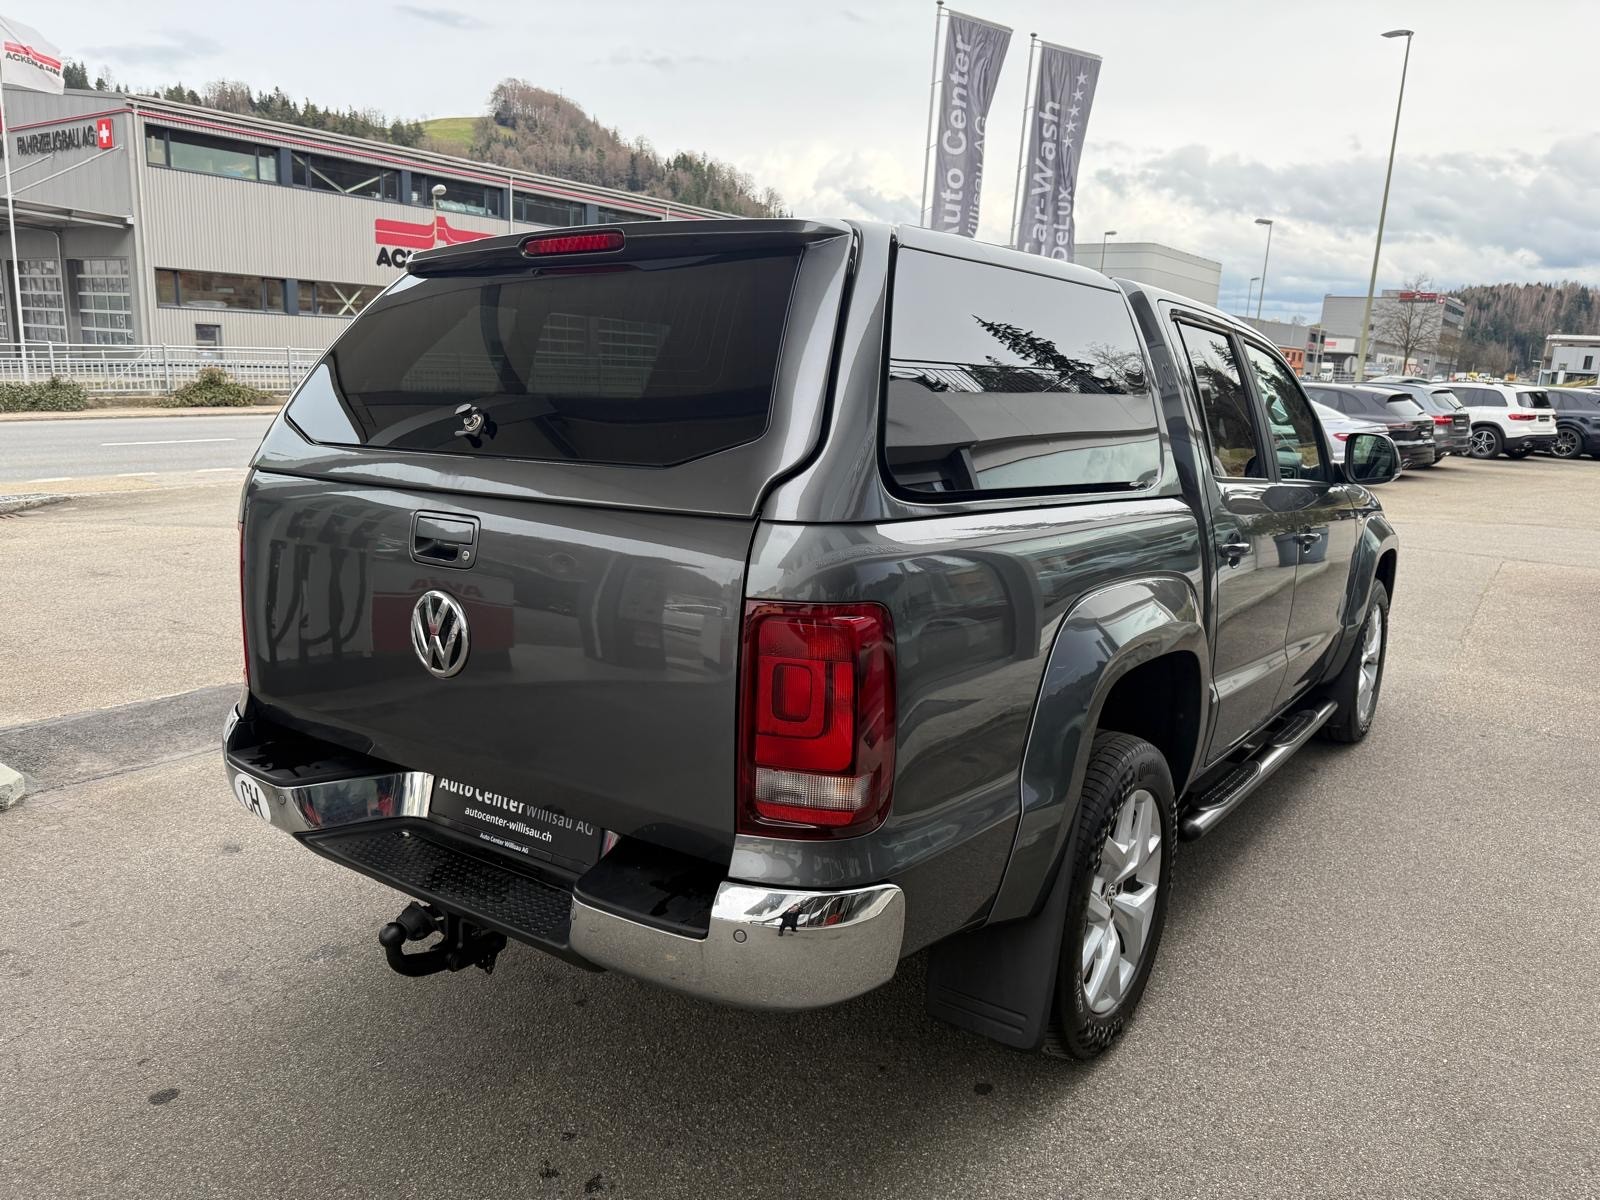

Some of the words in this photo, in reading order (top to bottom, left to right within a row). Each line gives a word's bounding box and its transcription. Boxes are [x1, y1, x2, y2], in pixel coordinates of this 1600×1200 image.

[942, 33, 972, 156] Center
[16, 127, 80, 155] FAHRZEUGBAU
[82, 125, 96, 147] AG
[241, 780, 265, 820] CH
[464, 807, 553, 843] autocenter-willisau.ch
[479, 832, 490, 840] Auto
[490, 835, 505, 846] Center
